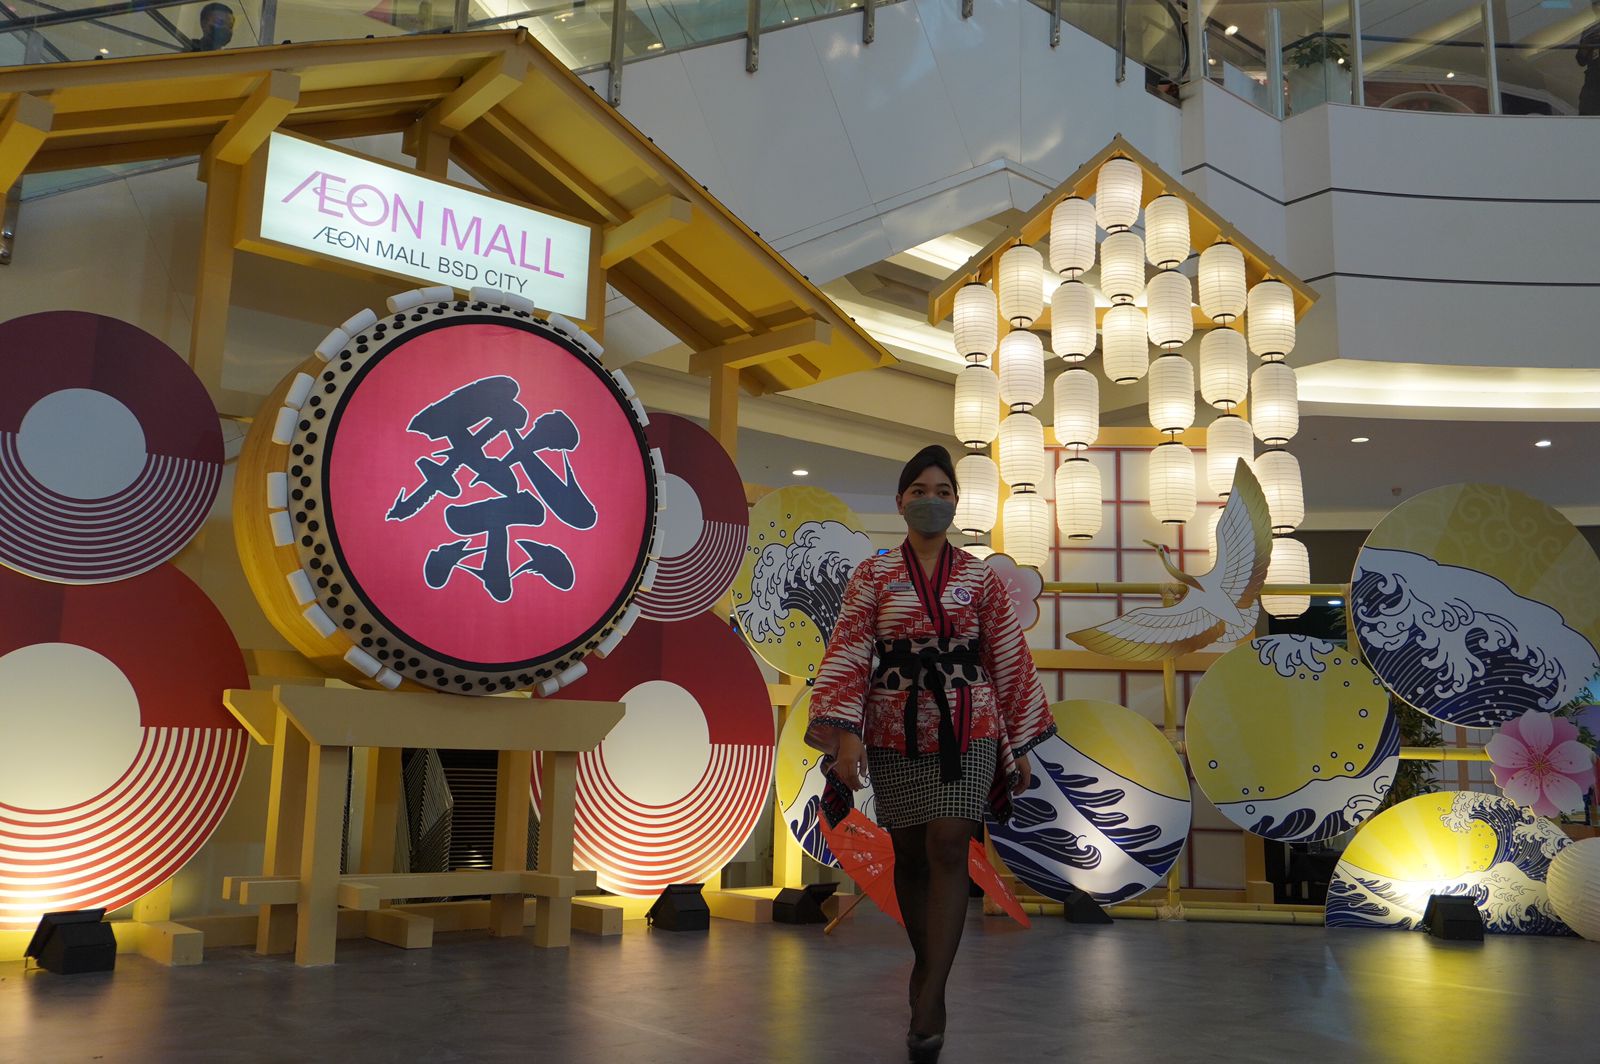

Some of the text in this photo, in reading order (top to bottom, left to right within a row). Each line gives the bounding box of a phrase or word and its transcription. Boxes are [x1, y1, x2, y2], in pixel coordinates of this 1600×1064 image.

[376, 240, 430, 270] MALL
[438, 257, 479, 281] BSD
[484, 269, 528, 293] CITY
[440, 207, 565, 279] MALL
[385, 375, 598, 603] 祭
